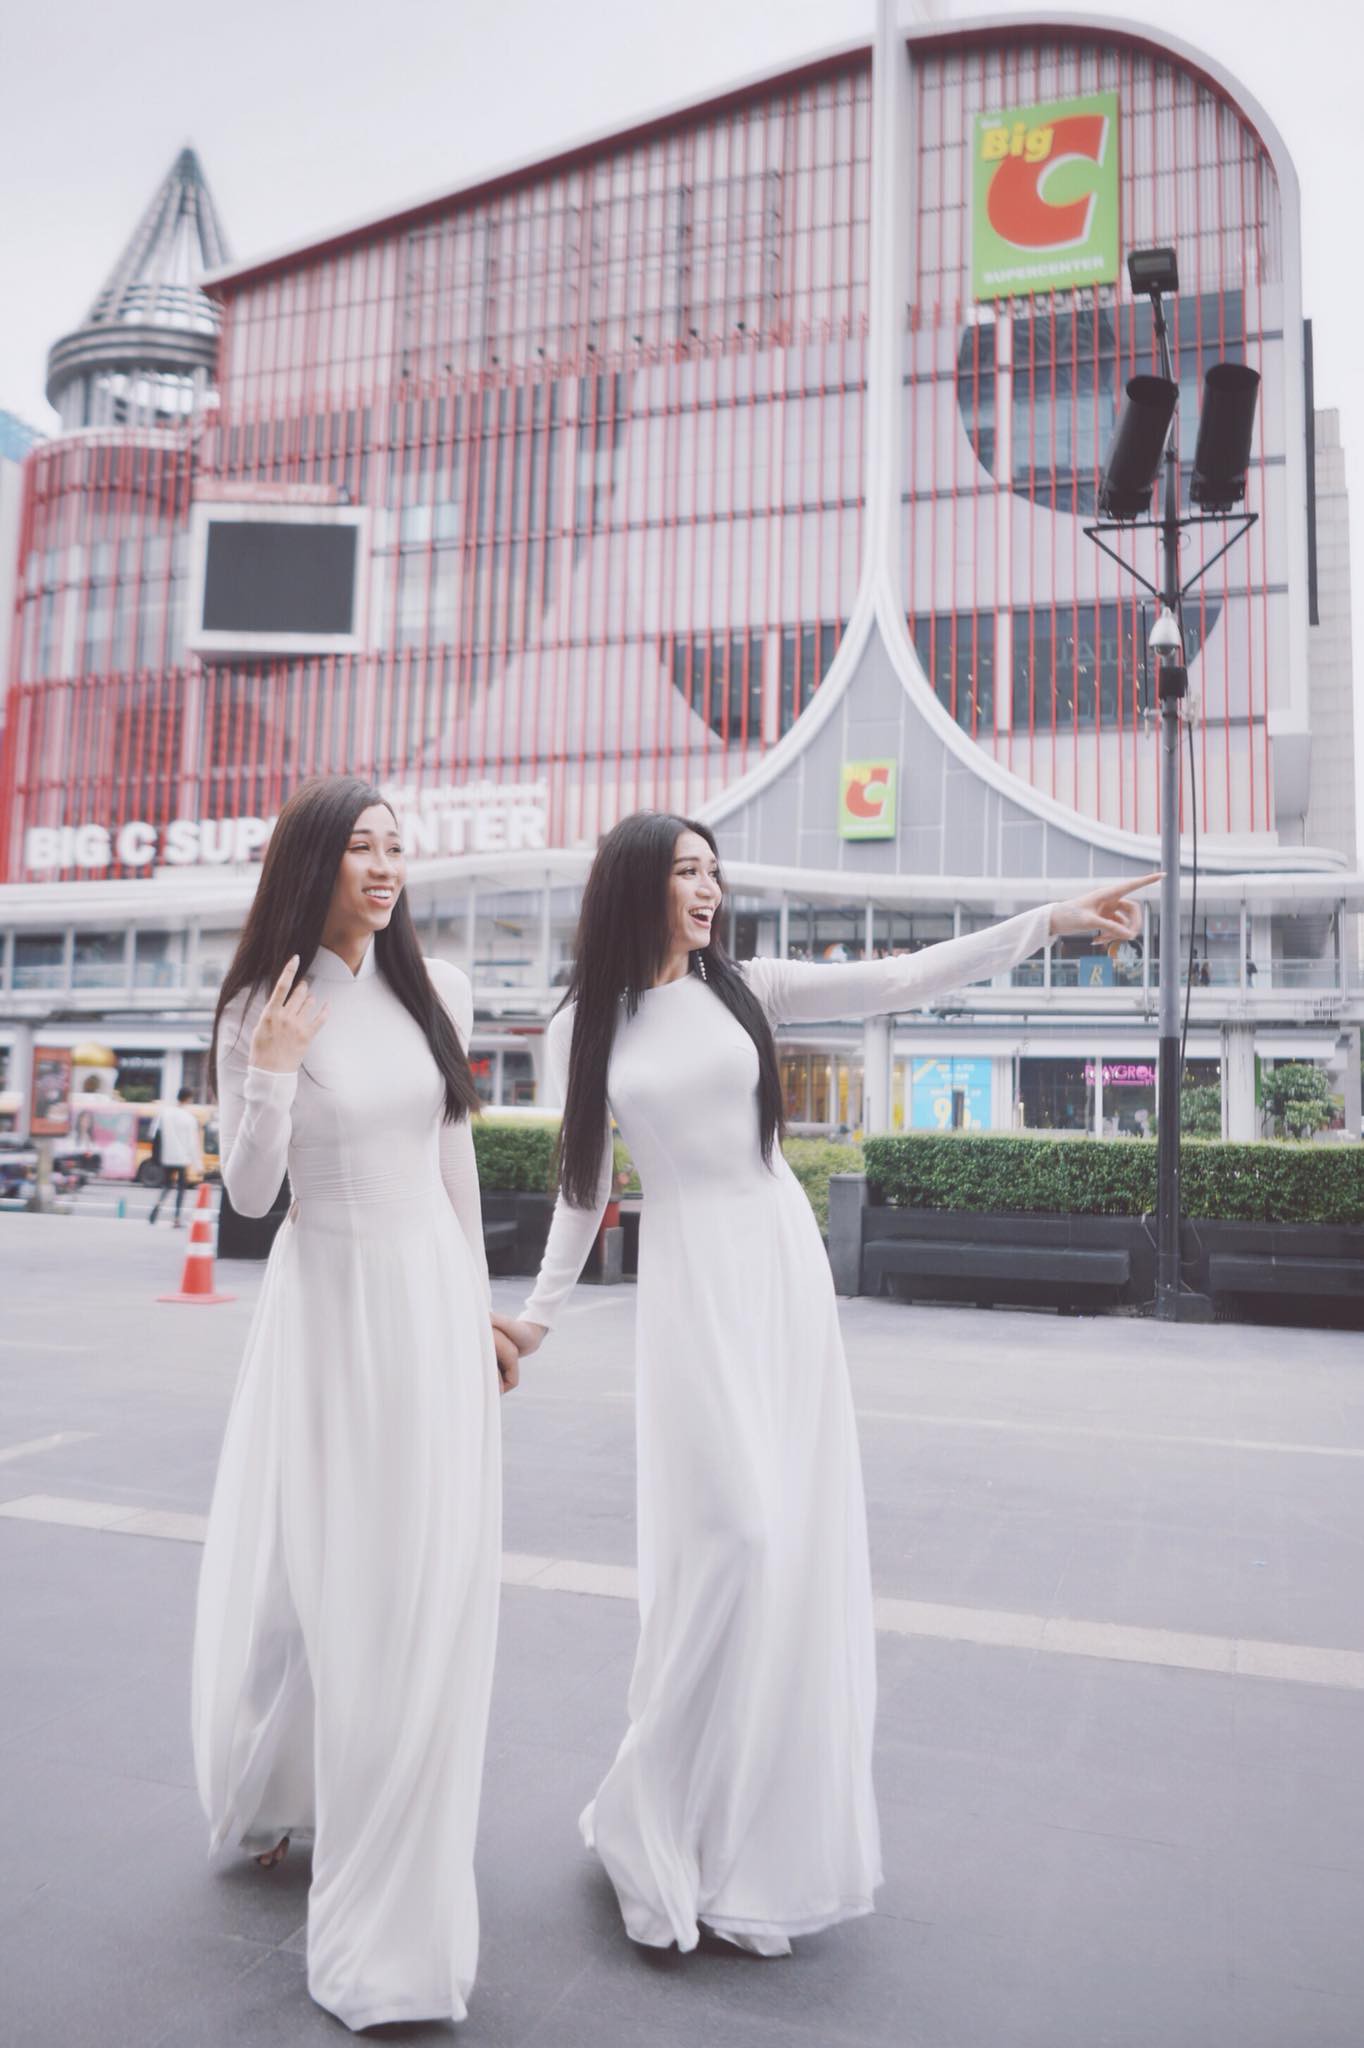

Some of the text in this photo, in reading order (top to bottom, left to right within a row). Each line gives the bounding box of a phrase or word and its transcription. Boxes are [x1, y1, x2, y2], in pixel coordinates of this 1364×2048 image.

[981, 115, 1109, 252] Big C
[983, 256, 1105, 284] SUPERCENTER
[26, 825, 112, 869] BIG
[117, 821, 157, 867] C
